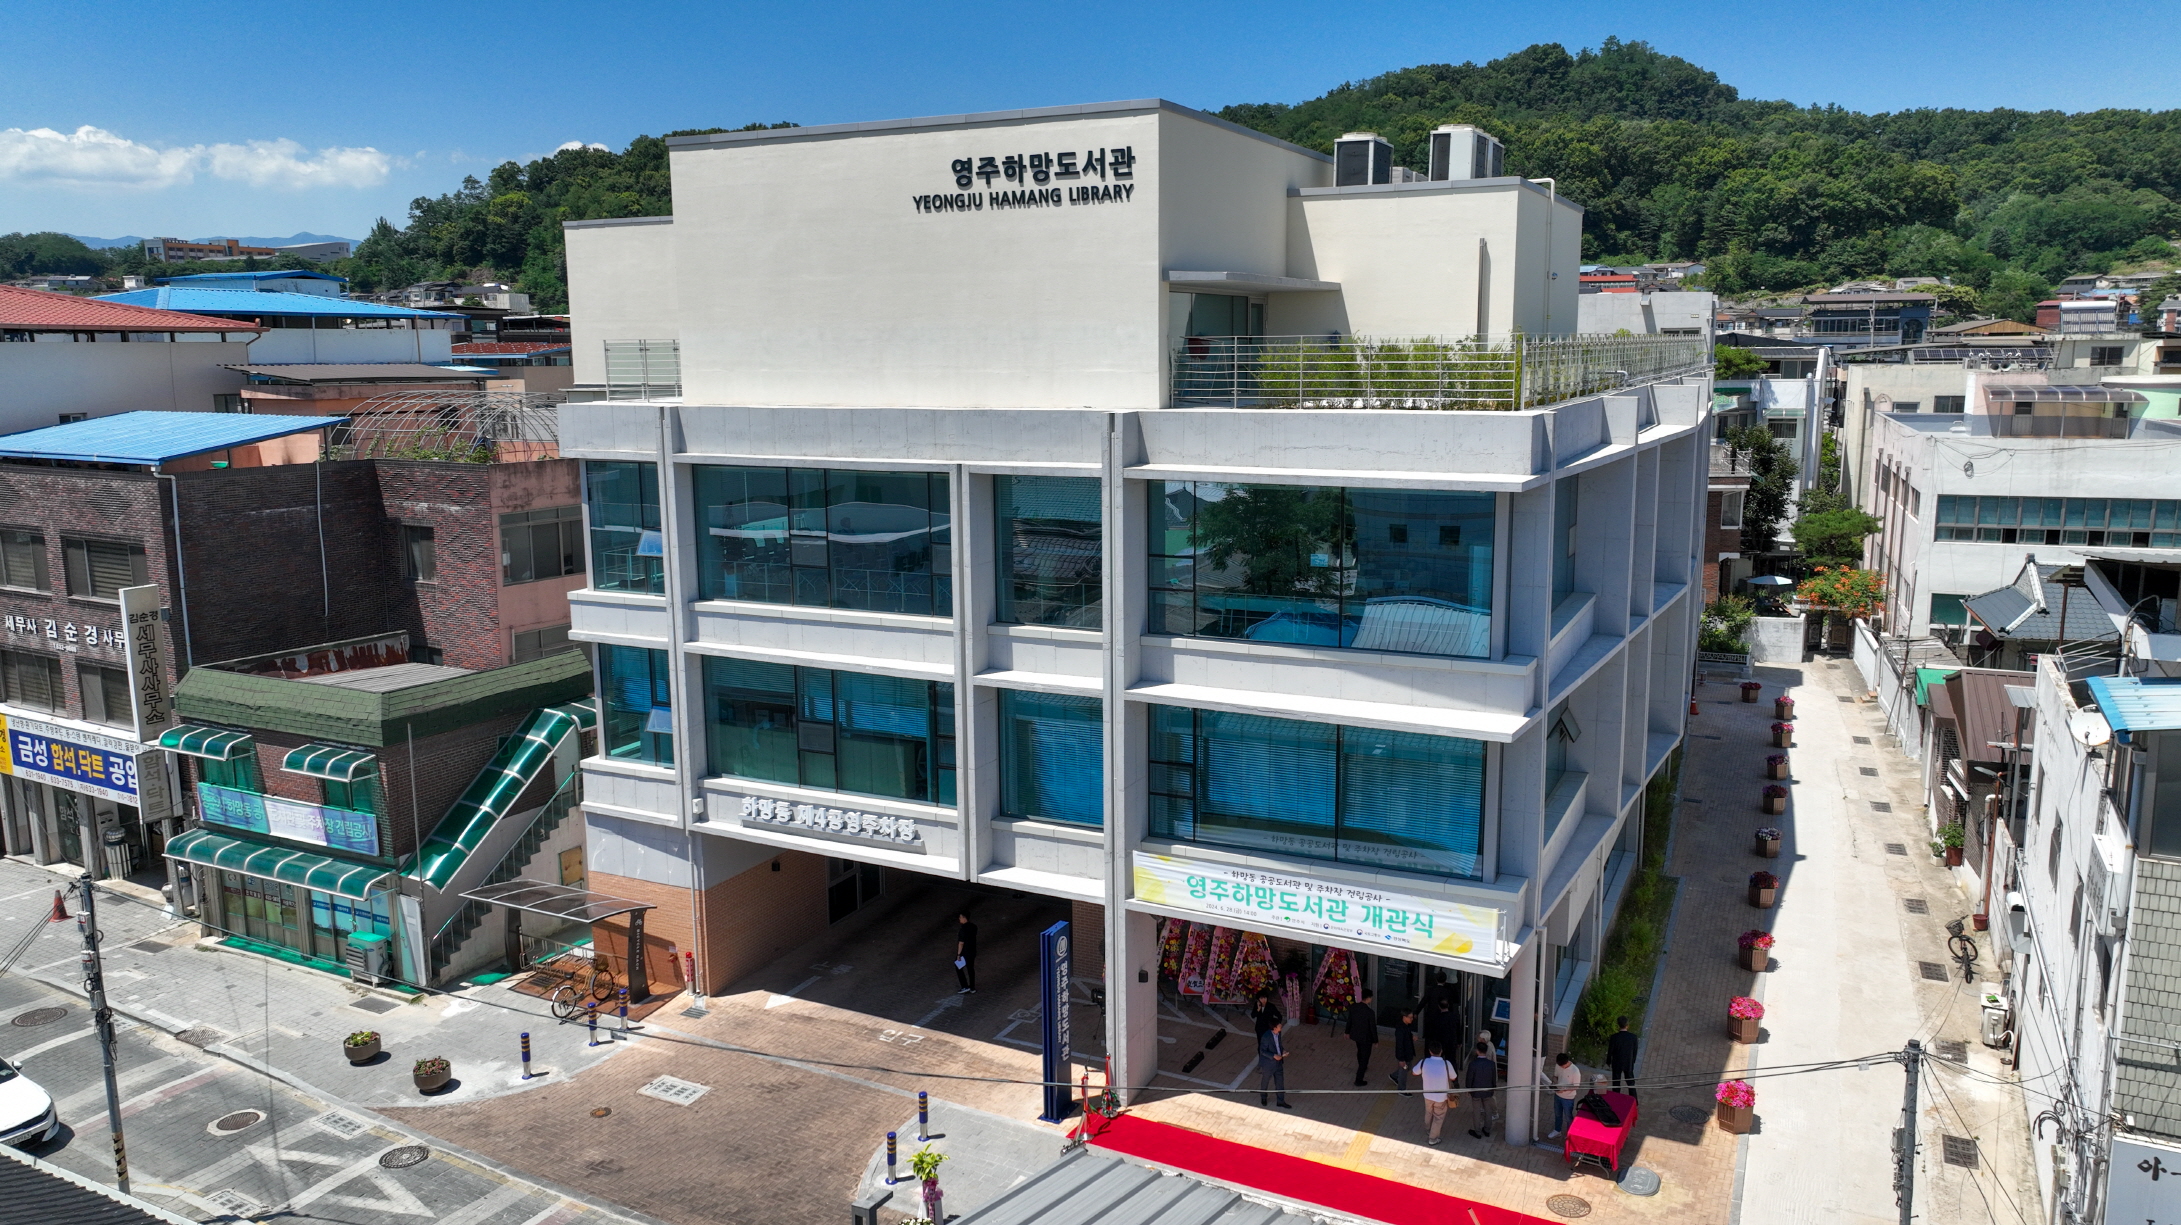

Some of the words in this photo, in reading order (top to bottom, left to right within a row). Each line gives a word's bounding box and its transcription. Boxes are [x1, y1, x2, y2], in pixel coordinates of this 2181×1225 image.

[951, 146, 1136, 188] 영주하망도서관
[913, 193, 983, 212] YEONGJU
[989, 188, 1062, 208] HAMANG
[1069, 183, 1134, 202] LIBRARY
[5, 615, 37, 634] 세무사
[129, 611, 159, 624] 김순경
[136, 624, 165, 725] 세무사사무소
[18, 735, 49, 767] 금성
[227, 798, 252, 818] 하망동
[308, 815, 334, 834] 주차장
[335, 820, 371, 840] 건립공사
[741, 796, 792, 823] 하망동
[797, 805, 917, 841] 제4공영주차장
[1232, 870, 1256, 882] 하망동
[1260, 875, 1301, 889] 공공도서관
[1304, 883, 1313, 892] 및
[1317, 884, 1343, 896] 주차장
[1346, 889, 1382, 902] 건립공사
[1186, 876, 1349, 924] 영주하망도서관
[1360, 901, 1435, 939] 개관식
[879, 1029, 926, 1046] 입구
